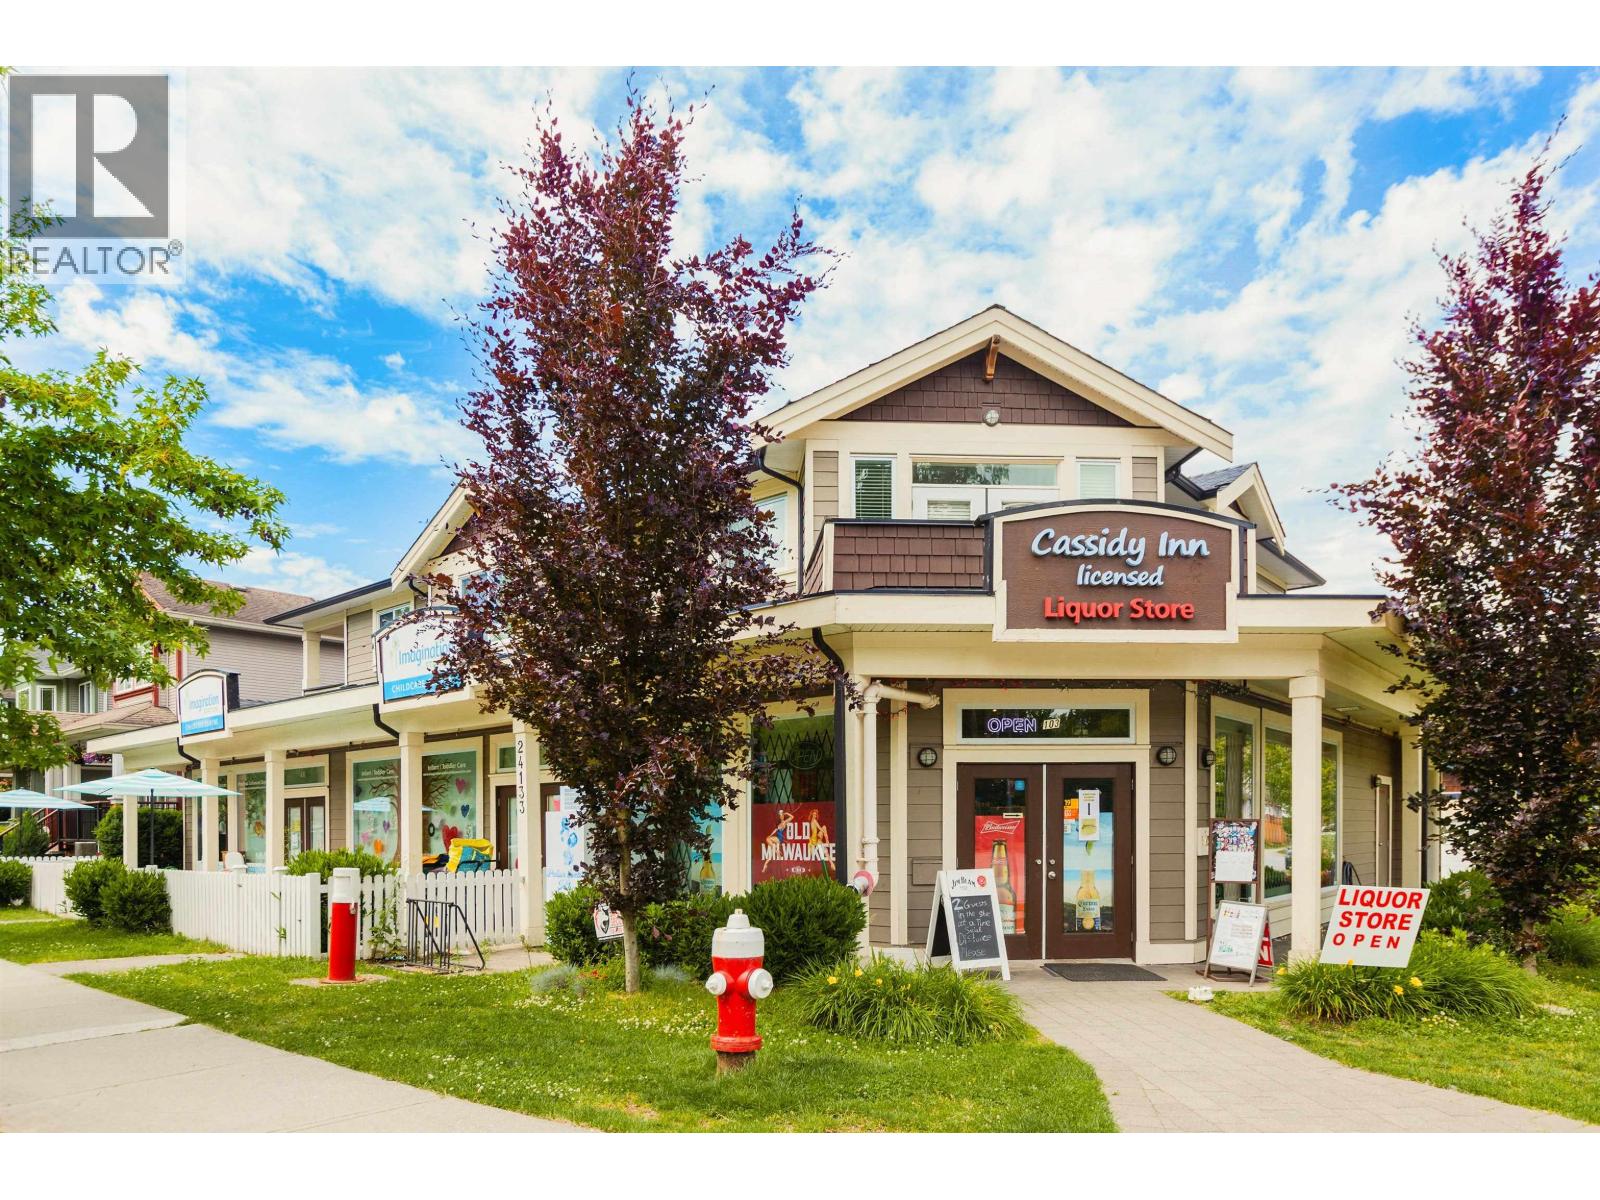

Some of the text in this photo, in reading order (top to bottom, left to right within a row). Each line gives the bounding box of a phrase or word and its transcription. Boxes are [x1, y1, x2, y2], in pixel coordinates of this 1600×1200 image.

[1031, 527, 1211, 566] Cassidy Inn
[1076, 564, 1164, 587] licensed
[1044, 597, 1195, 624] Liquor Store
[987, 717, 1060, 733] OPEN 103
[517, 740, 525, 814] 24133
[786, 821, 811, 840] OLD
[761, 843, 837, 861] MILWAUKEE
[951, 898, 963, 911] 2
[1338, 889, 1423, 909] LIQUOR
[1339, 911, 1413, 931] STORE
[1332, 933, 1400, 949] OPEN
